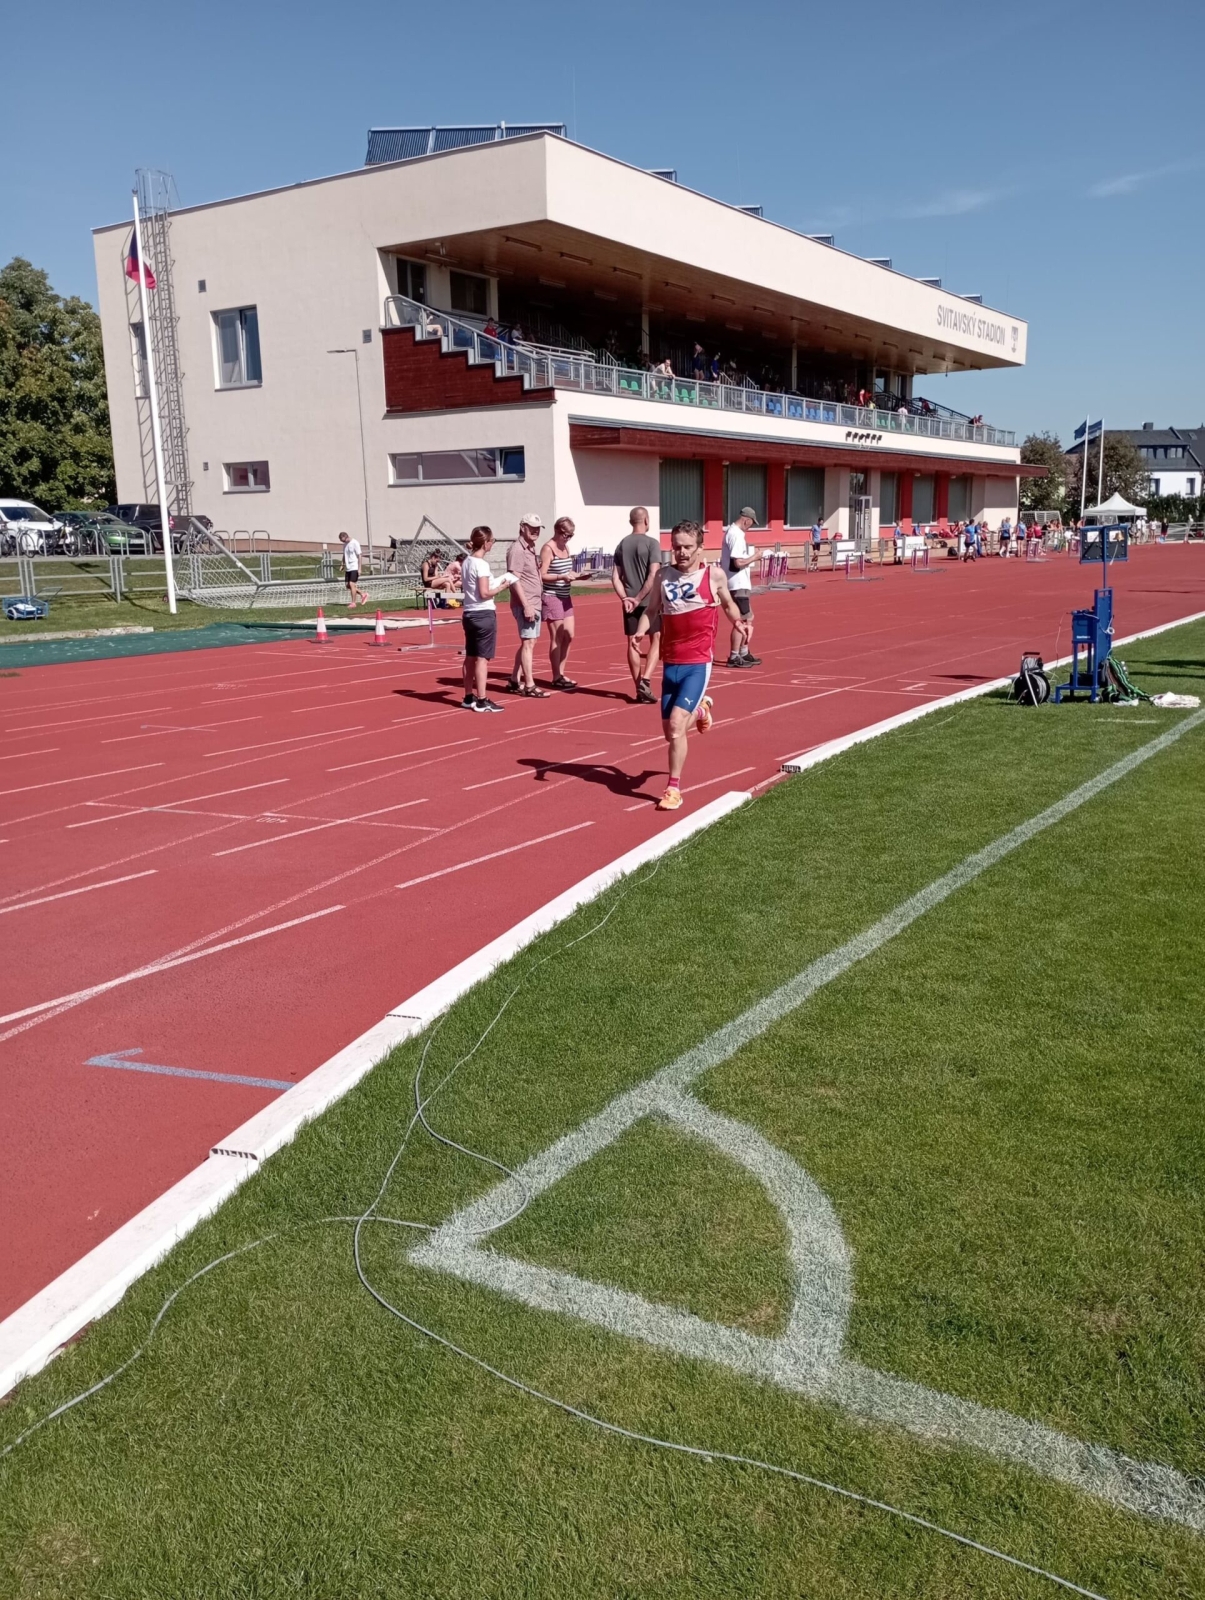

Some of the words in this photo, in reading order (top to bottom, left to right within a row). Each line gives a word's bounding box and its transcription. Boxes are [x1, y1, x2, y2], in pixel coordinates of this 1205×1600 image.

[937, 305, 977, 337] SVITAVSKÝ
[977, 318, 1006, 346] STADION
[664, 582, 696, 603] 32
